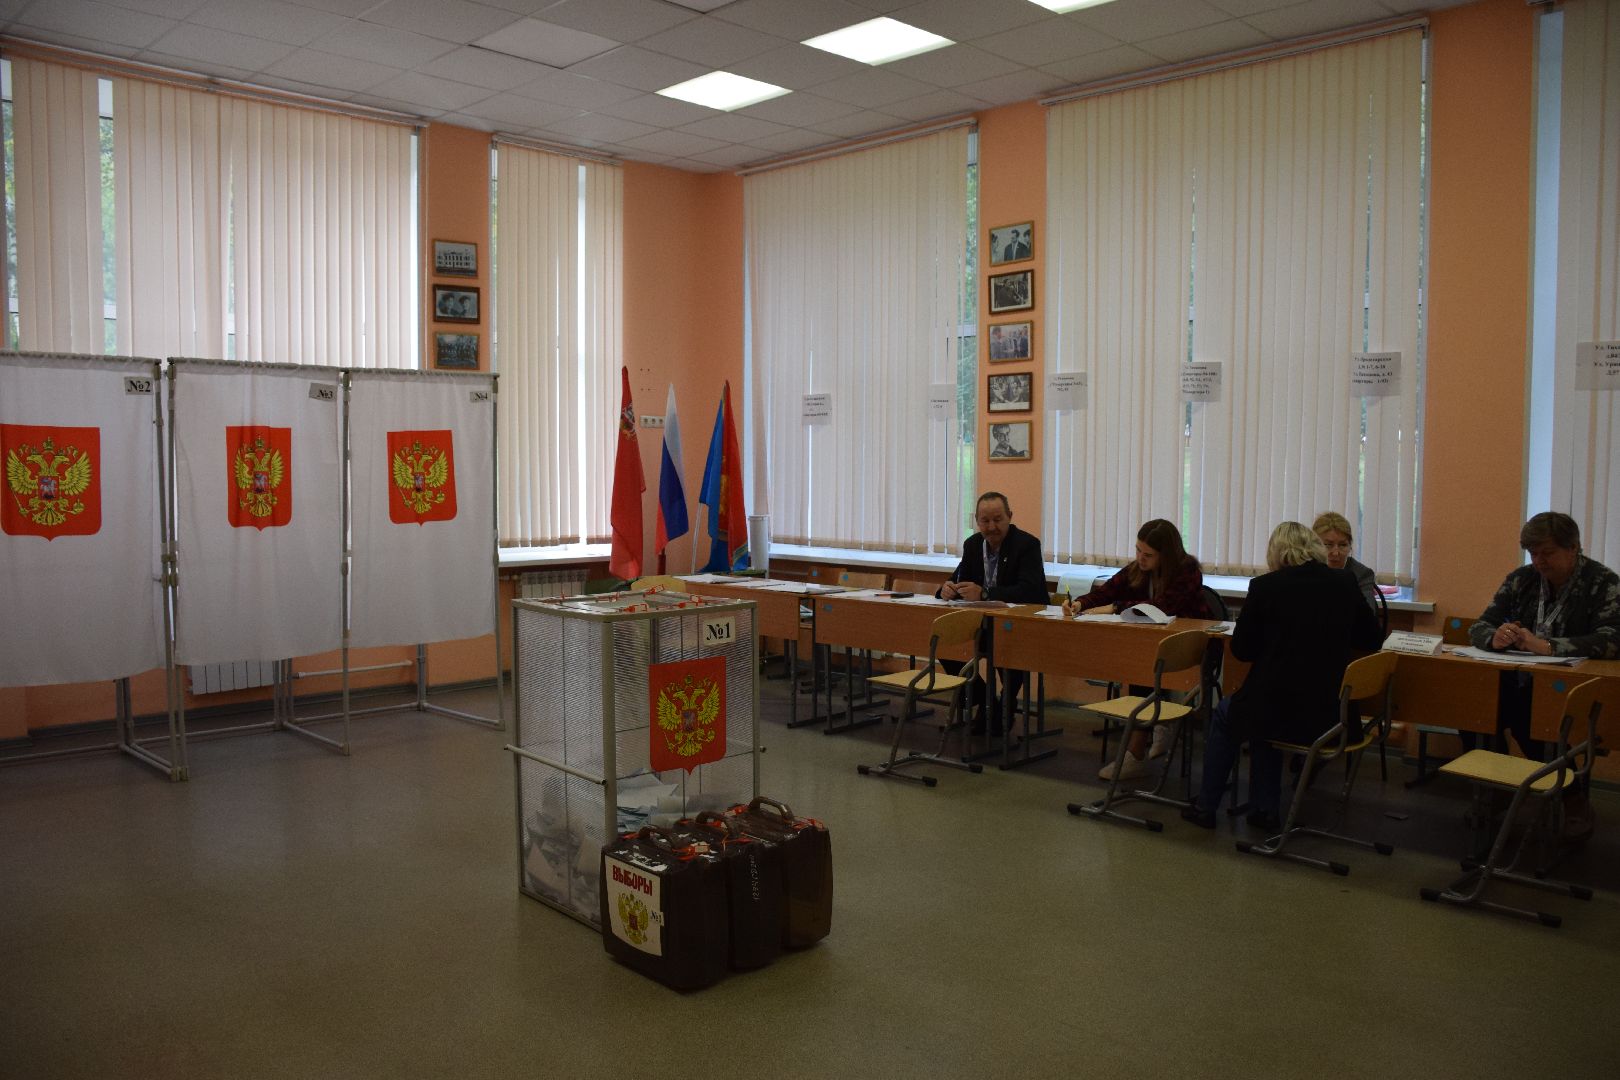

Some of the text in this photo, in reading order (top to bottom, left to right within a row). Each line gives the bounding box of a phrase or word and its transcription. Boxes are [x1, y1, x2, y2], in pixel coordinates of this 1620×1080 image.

[127, 380, 151, 393] №2
[317, 389, 334, 399] №3
[706, 622, 731, 641] №1
[612, 864, 653, 897] ВЫБОРЫ
